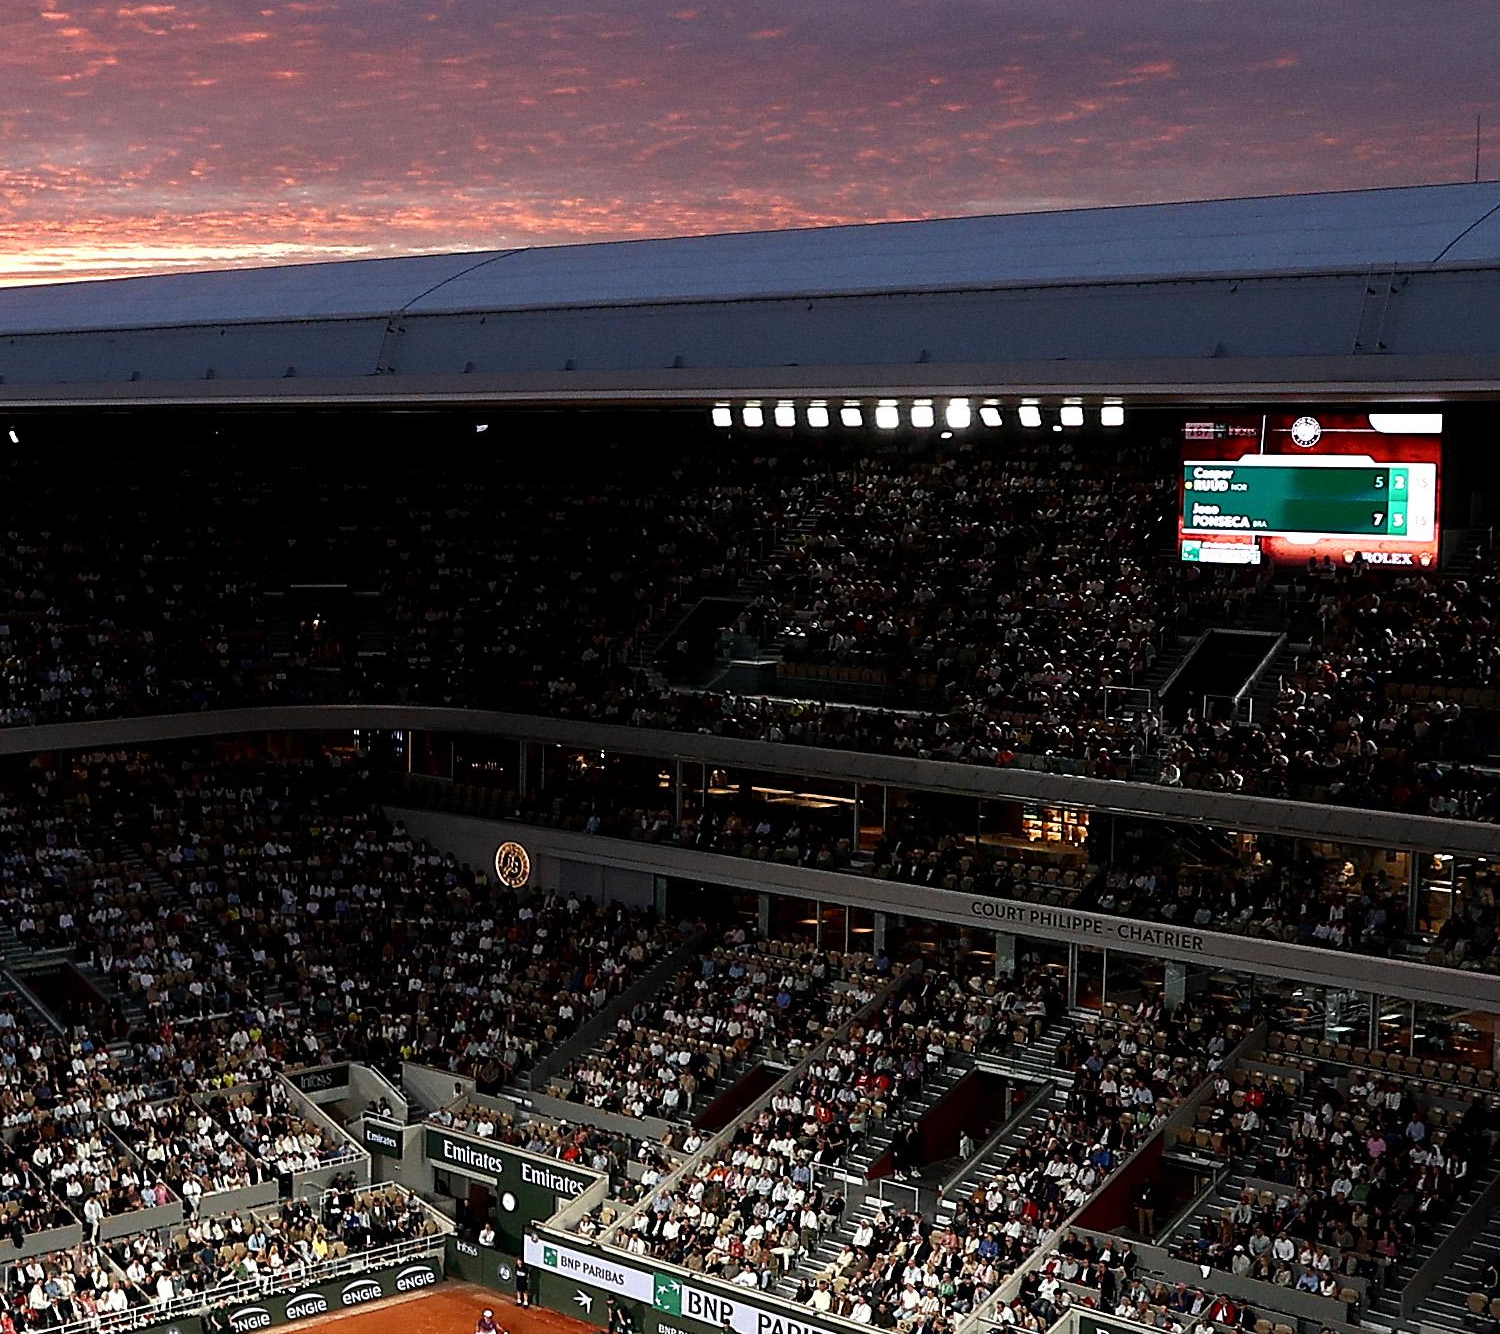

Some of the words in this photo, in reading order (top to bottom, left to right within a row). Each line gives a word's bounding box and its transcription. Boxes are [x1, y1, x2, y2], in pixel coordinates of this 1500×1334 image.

[1193, 480, 1229, 491] RUUD
[1375, 476, 1385, 488] 5
[1394, 475, 1405, 489] 2
[1193, 516, 1250, 528] FONSECA
[1373, 513, 1384, 526] 7
[1392, 513, 1404, 527] 3
[971, 901, 1026, 922] COURT
[1030, 910, 1103, 934] PHILIPPE
[1118, 923, 1204, 951] CHATRIER
[443, 1139, 503, 1173] Emirates
[521, 1162, 585, 1196] Emirates
[560, 1255, 581, 1272] BNP
[583, 1263, 625, 1286] PARIBAS
[688, 1290, 734, 1324] BNP
